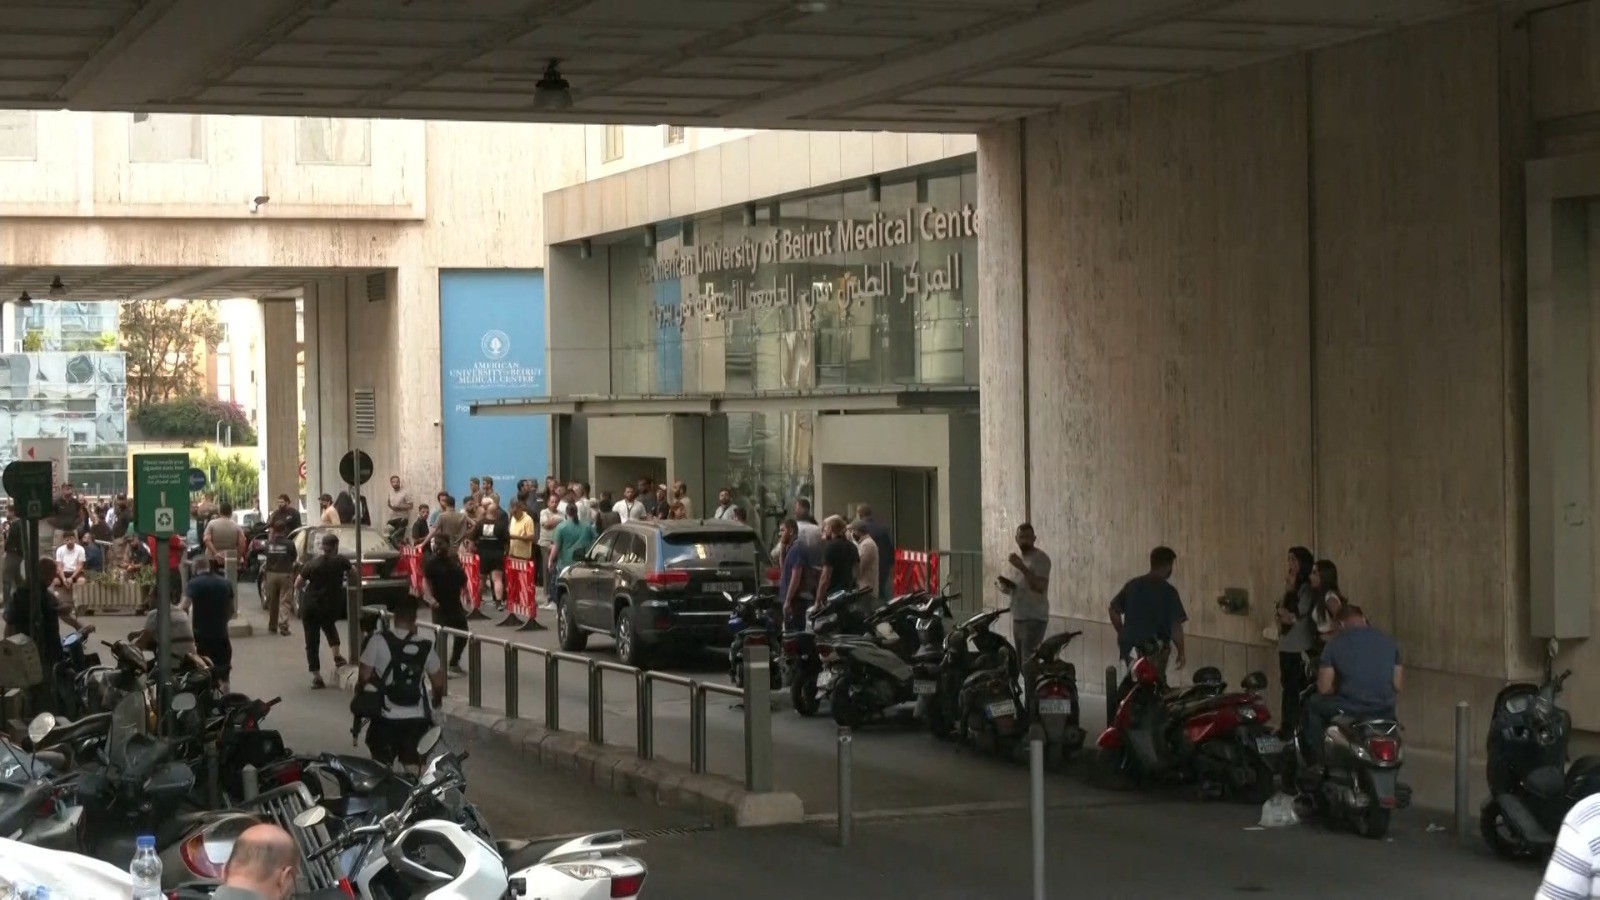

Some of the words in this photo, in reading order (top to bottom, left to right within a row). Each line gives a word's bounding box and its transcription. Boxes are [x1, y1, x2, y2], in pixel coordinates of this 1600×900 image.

[650, 251, 694, 283] American
[696, 238, 758, 274] University
[763, 229, 781, 262] of
[782, 224, 832, 260] Beirut
[837, 208, 912, 252] Medical
[803, 275, 832, 312] في
[838, 261, 892, 310] الطبي
[900, 253, 960, 304] المركز
[449, 368, 502, 377] UNIVERSITY
[510, 368, 542, 376] BEIRUT
[459, 376, 498, 384] MEDICAL
[499, 375, 534, 383] CENTER
